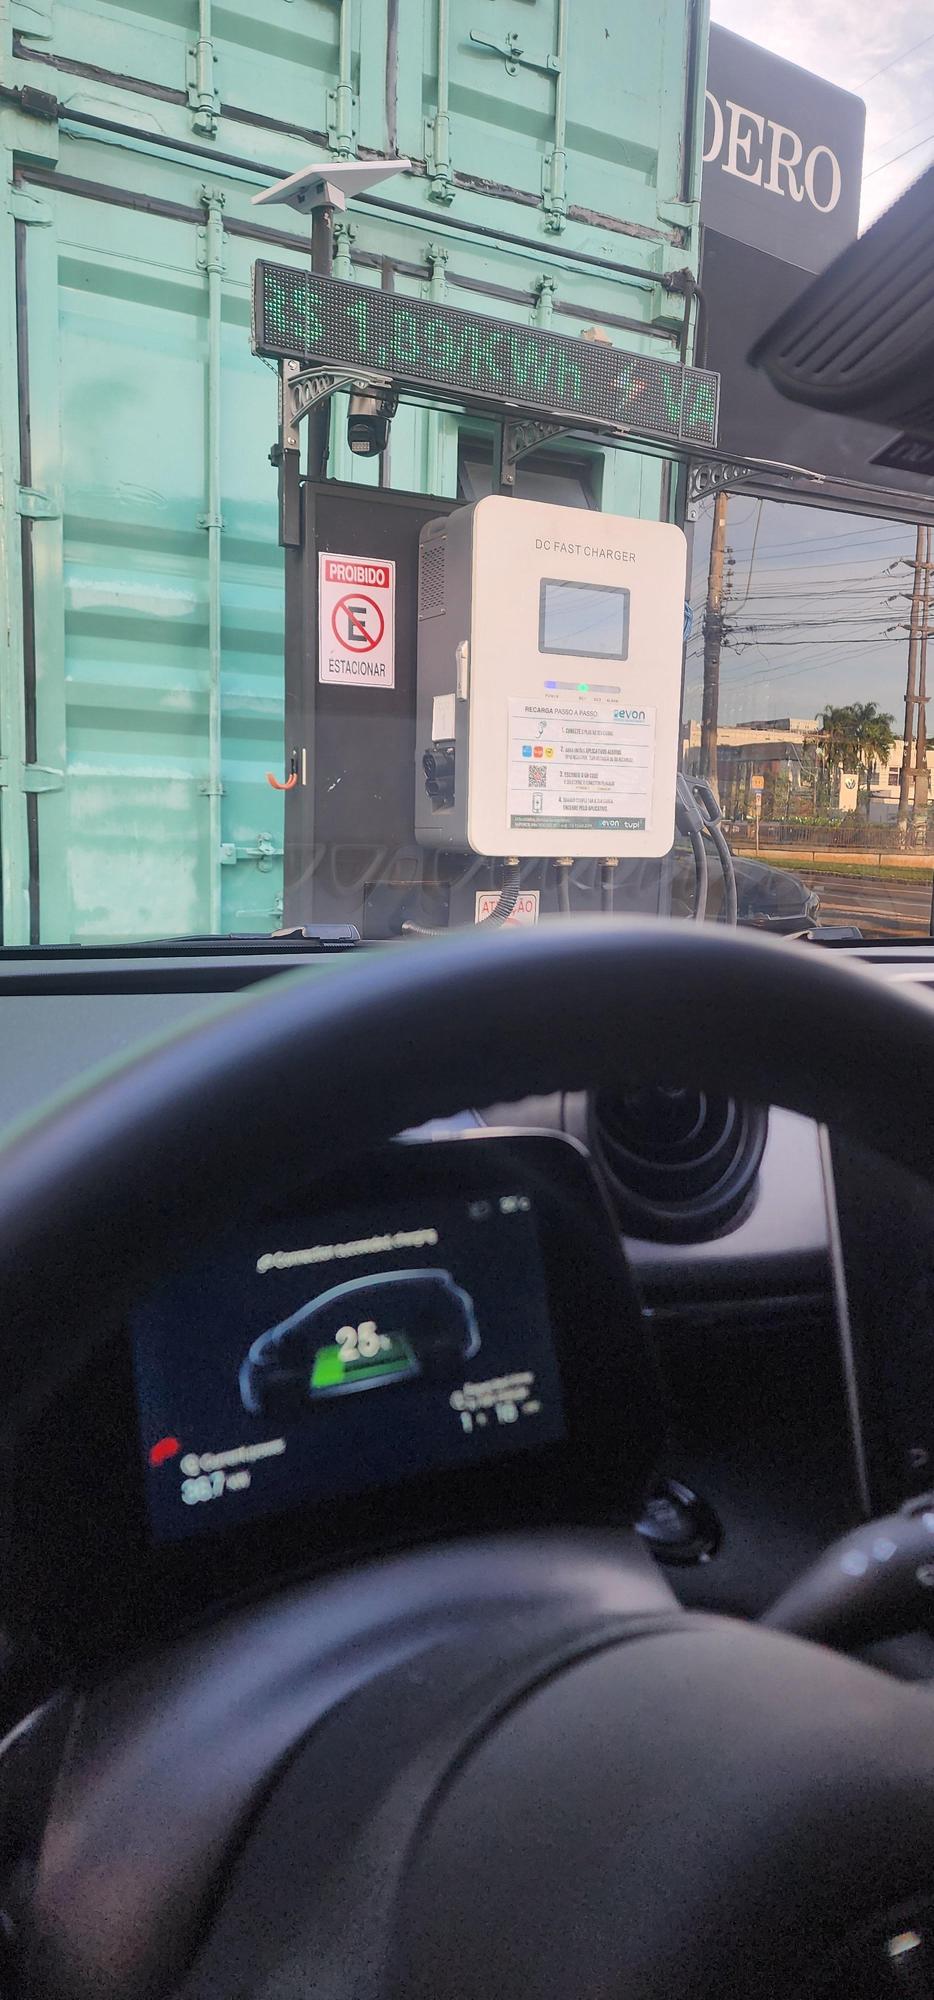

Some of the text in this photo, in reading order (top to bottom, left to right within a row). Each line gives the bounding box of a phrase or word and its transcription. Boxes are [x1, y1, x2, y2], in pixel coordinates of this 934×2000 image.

[535, 538, 636, 563] DC FAST CHARGER
[329, 563, 386, 587] PROIBIDO
[328, 658, 387, 678] ESTACIONAR
[524, 706, 554, 715] RECARGA
[554, 708, 573, 716] PASSO
[579, 710, 598, 718] PASSO
[482, 897, 534, 914] ATÃO
